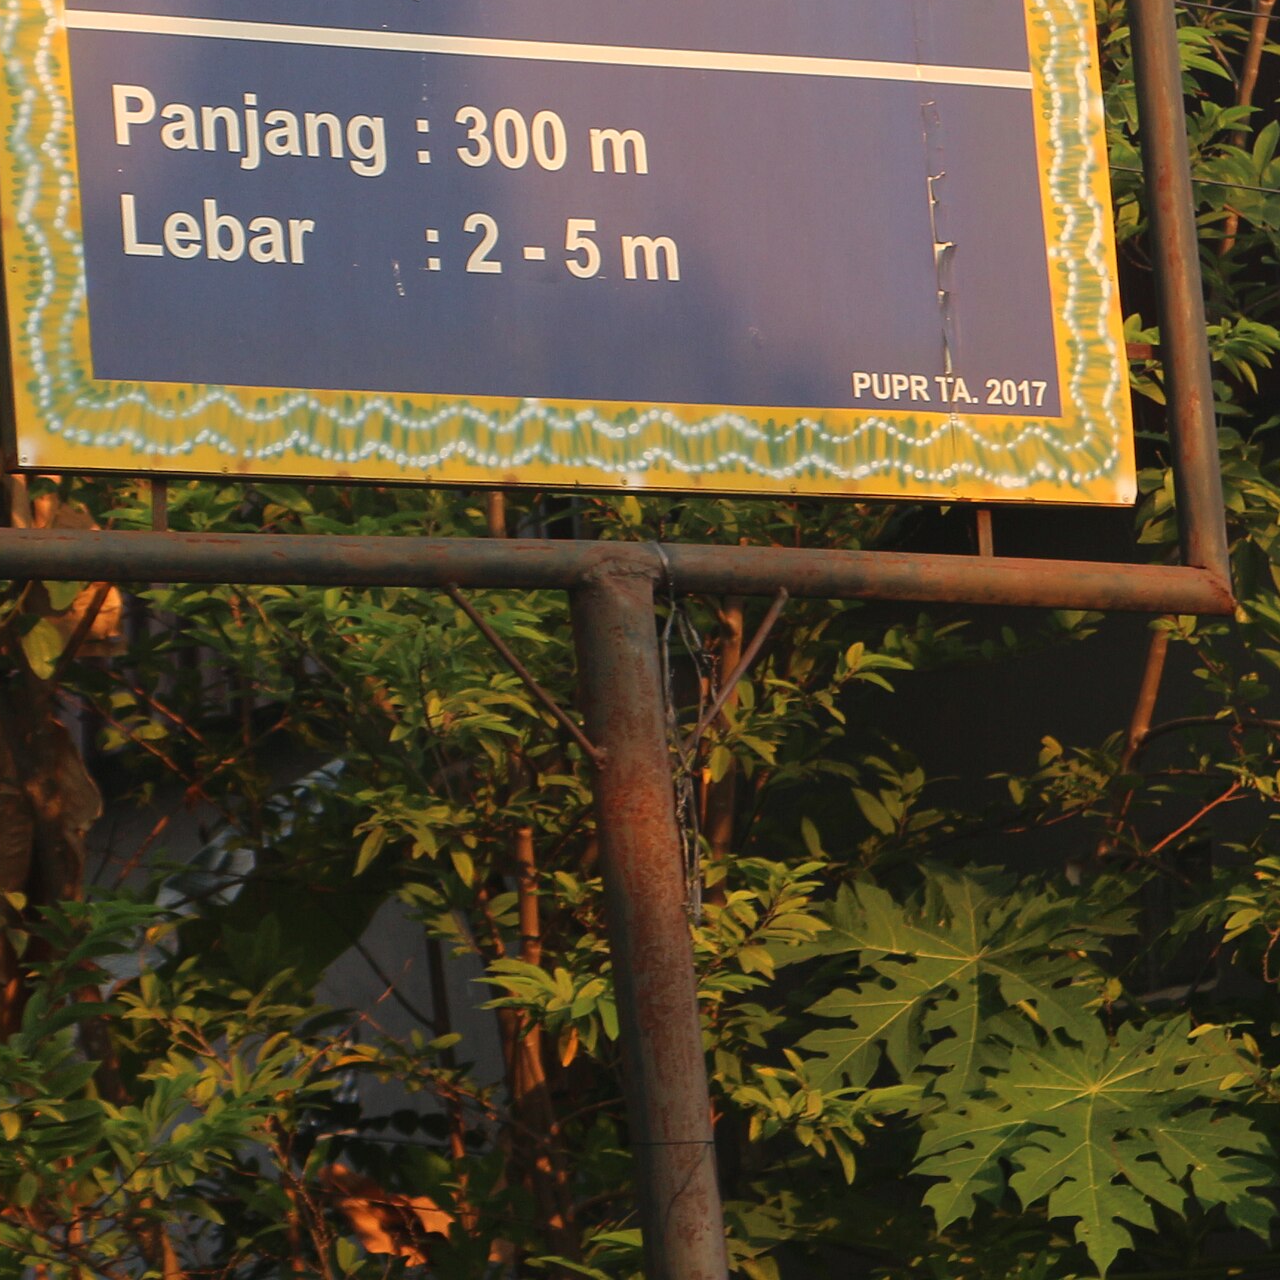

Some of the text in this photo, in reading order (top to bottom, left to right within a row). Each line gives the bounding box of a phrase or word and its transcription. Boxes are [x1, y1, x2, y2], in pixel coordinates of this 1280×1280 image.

[112, 84, 387, 177] Panjang
[455, 106, 568, 171] 300
[589, 128, 649, 175] m
[120, 194, 315, 264] Lebar
[621, 235, 680, 281] m
[852, 371, 1048, 407] PUPR TA. 2017
